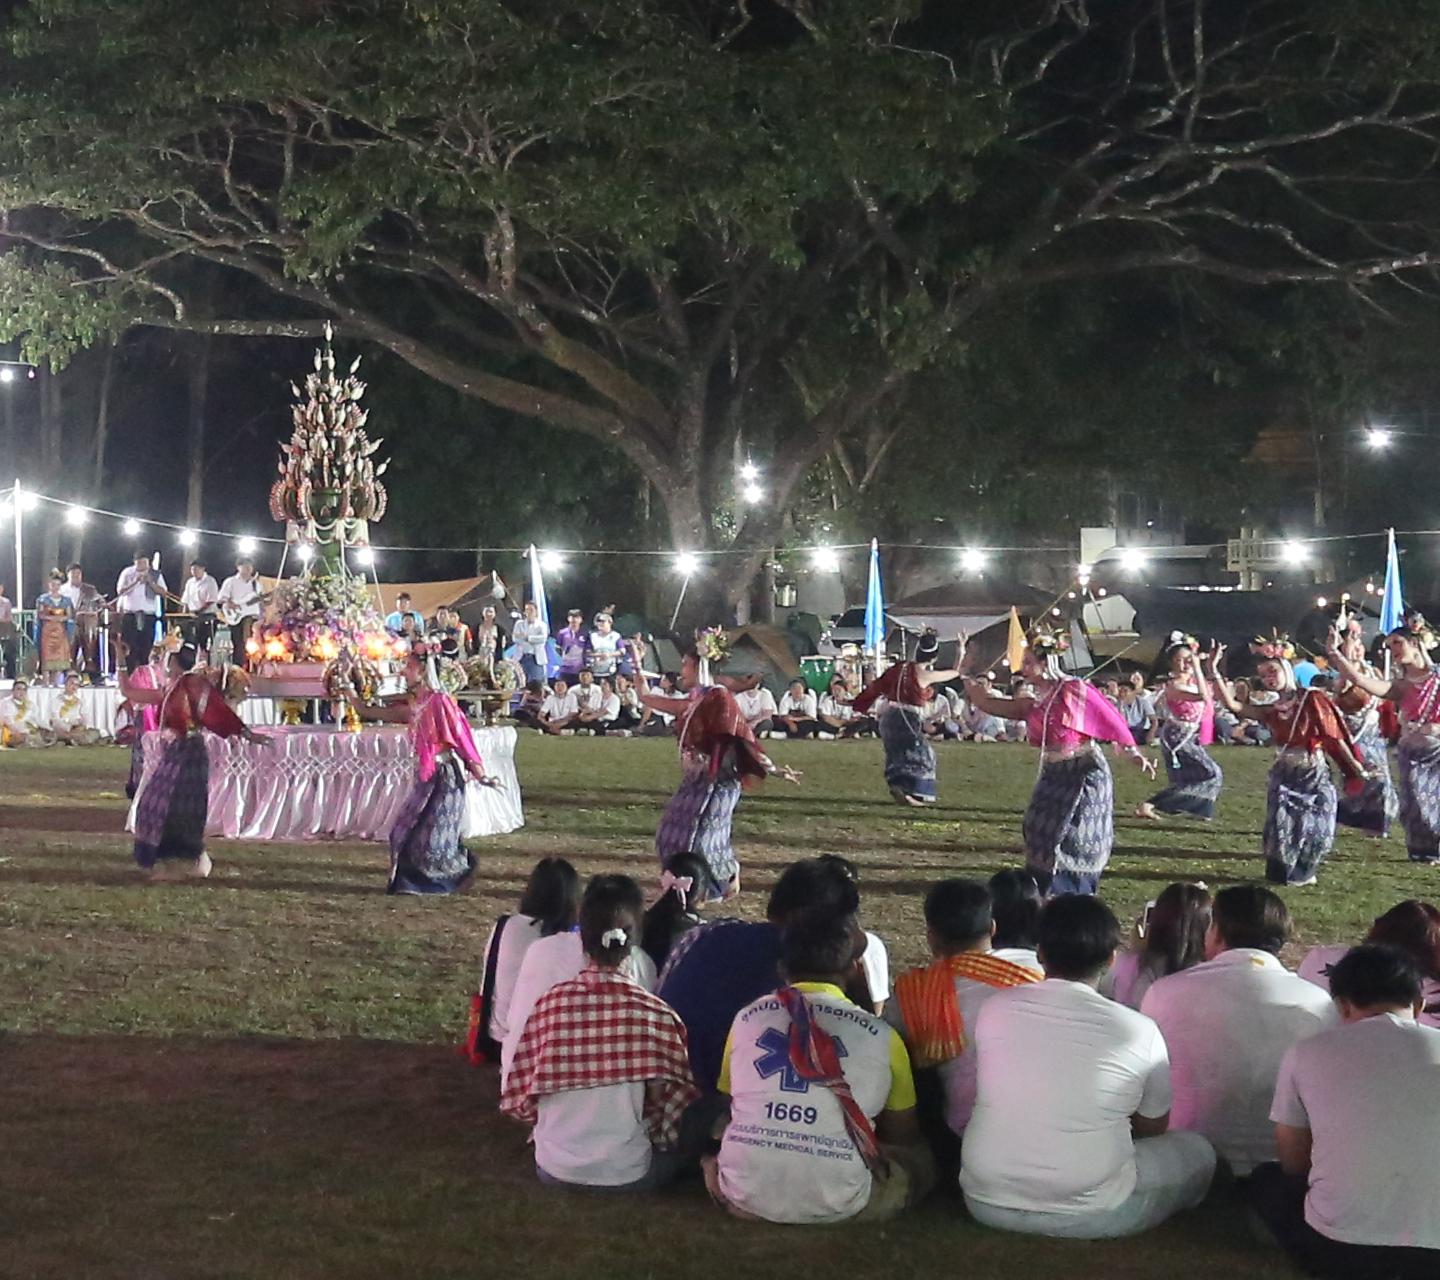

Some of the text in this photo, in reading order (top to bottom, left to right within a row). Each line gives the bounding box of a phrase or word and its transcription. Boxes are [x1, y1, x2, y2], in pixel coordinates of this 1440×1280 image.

[764, 1101, 818, 1125] 1669
[774, 1142, 815, 1155] MEDICAL
[817, 1148, 854, 1161] SERVICE
